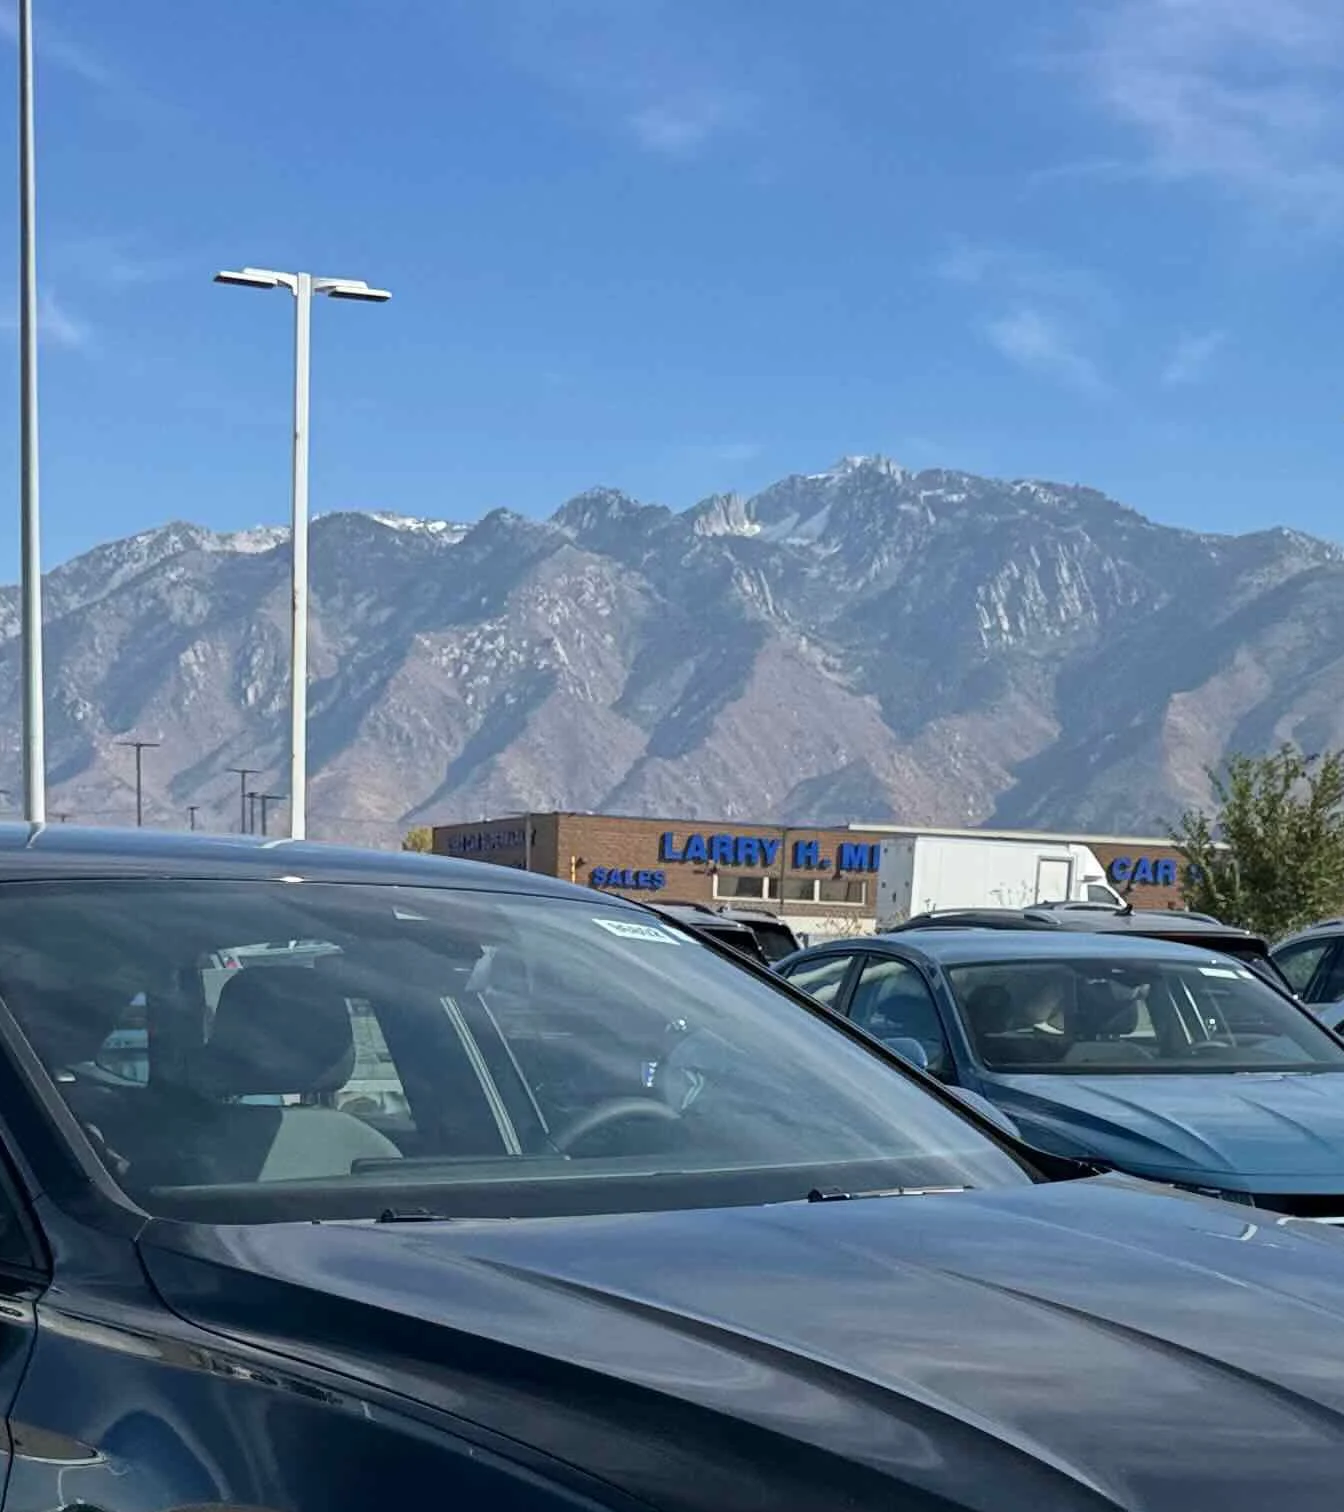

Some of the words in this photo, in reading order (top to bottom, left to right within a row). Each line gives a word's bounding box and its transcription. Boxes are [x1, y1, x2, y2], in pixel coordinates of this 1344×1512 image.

[659, 831, 781, 867] LARRY
[793, 839, 832, 869] H.
[1111, 856, 1177, 885] CAR
[591, 866, 665, 889] SALES
